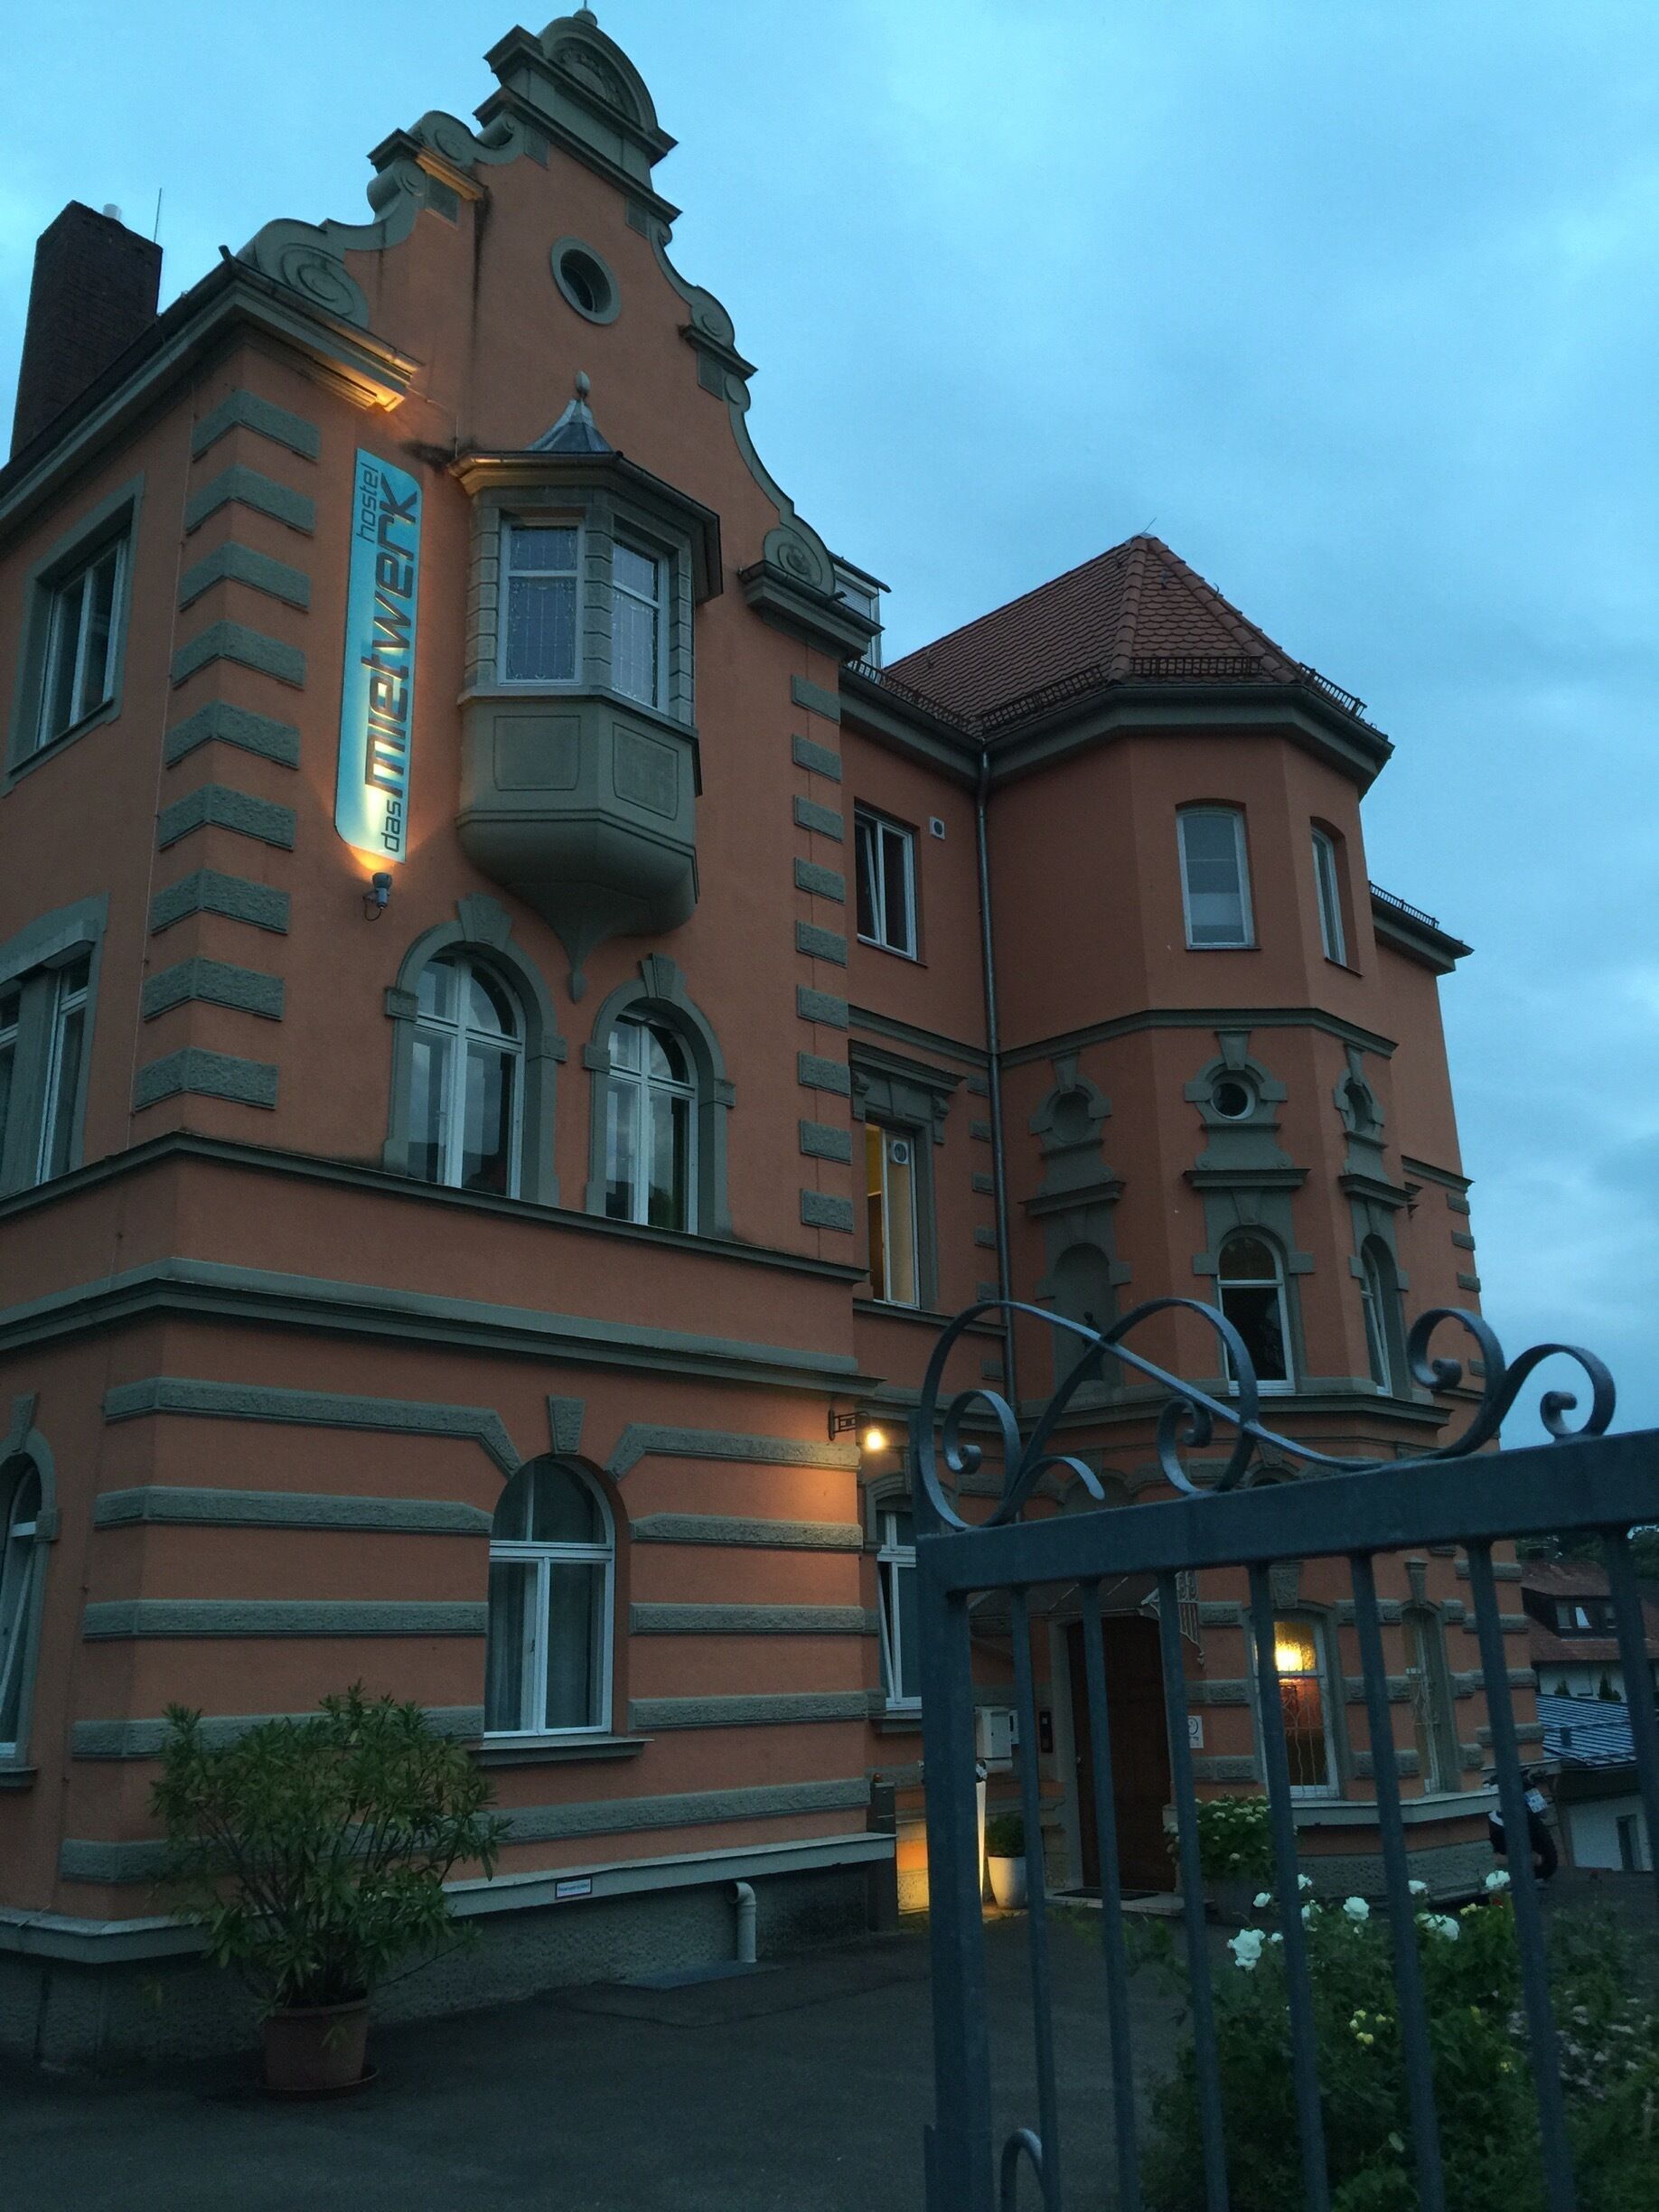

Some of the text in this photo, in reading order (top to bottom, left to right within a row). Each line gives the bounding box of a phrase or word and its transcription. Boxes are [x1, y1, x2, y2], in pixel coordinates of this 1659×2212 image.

[356, 462, 379, 542] hostel
[361, 473, 417, 853] das mietwerk
